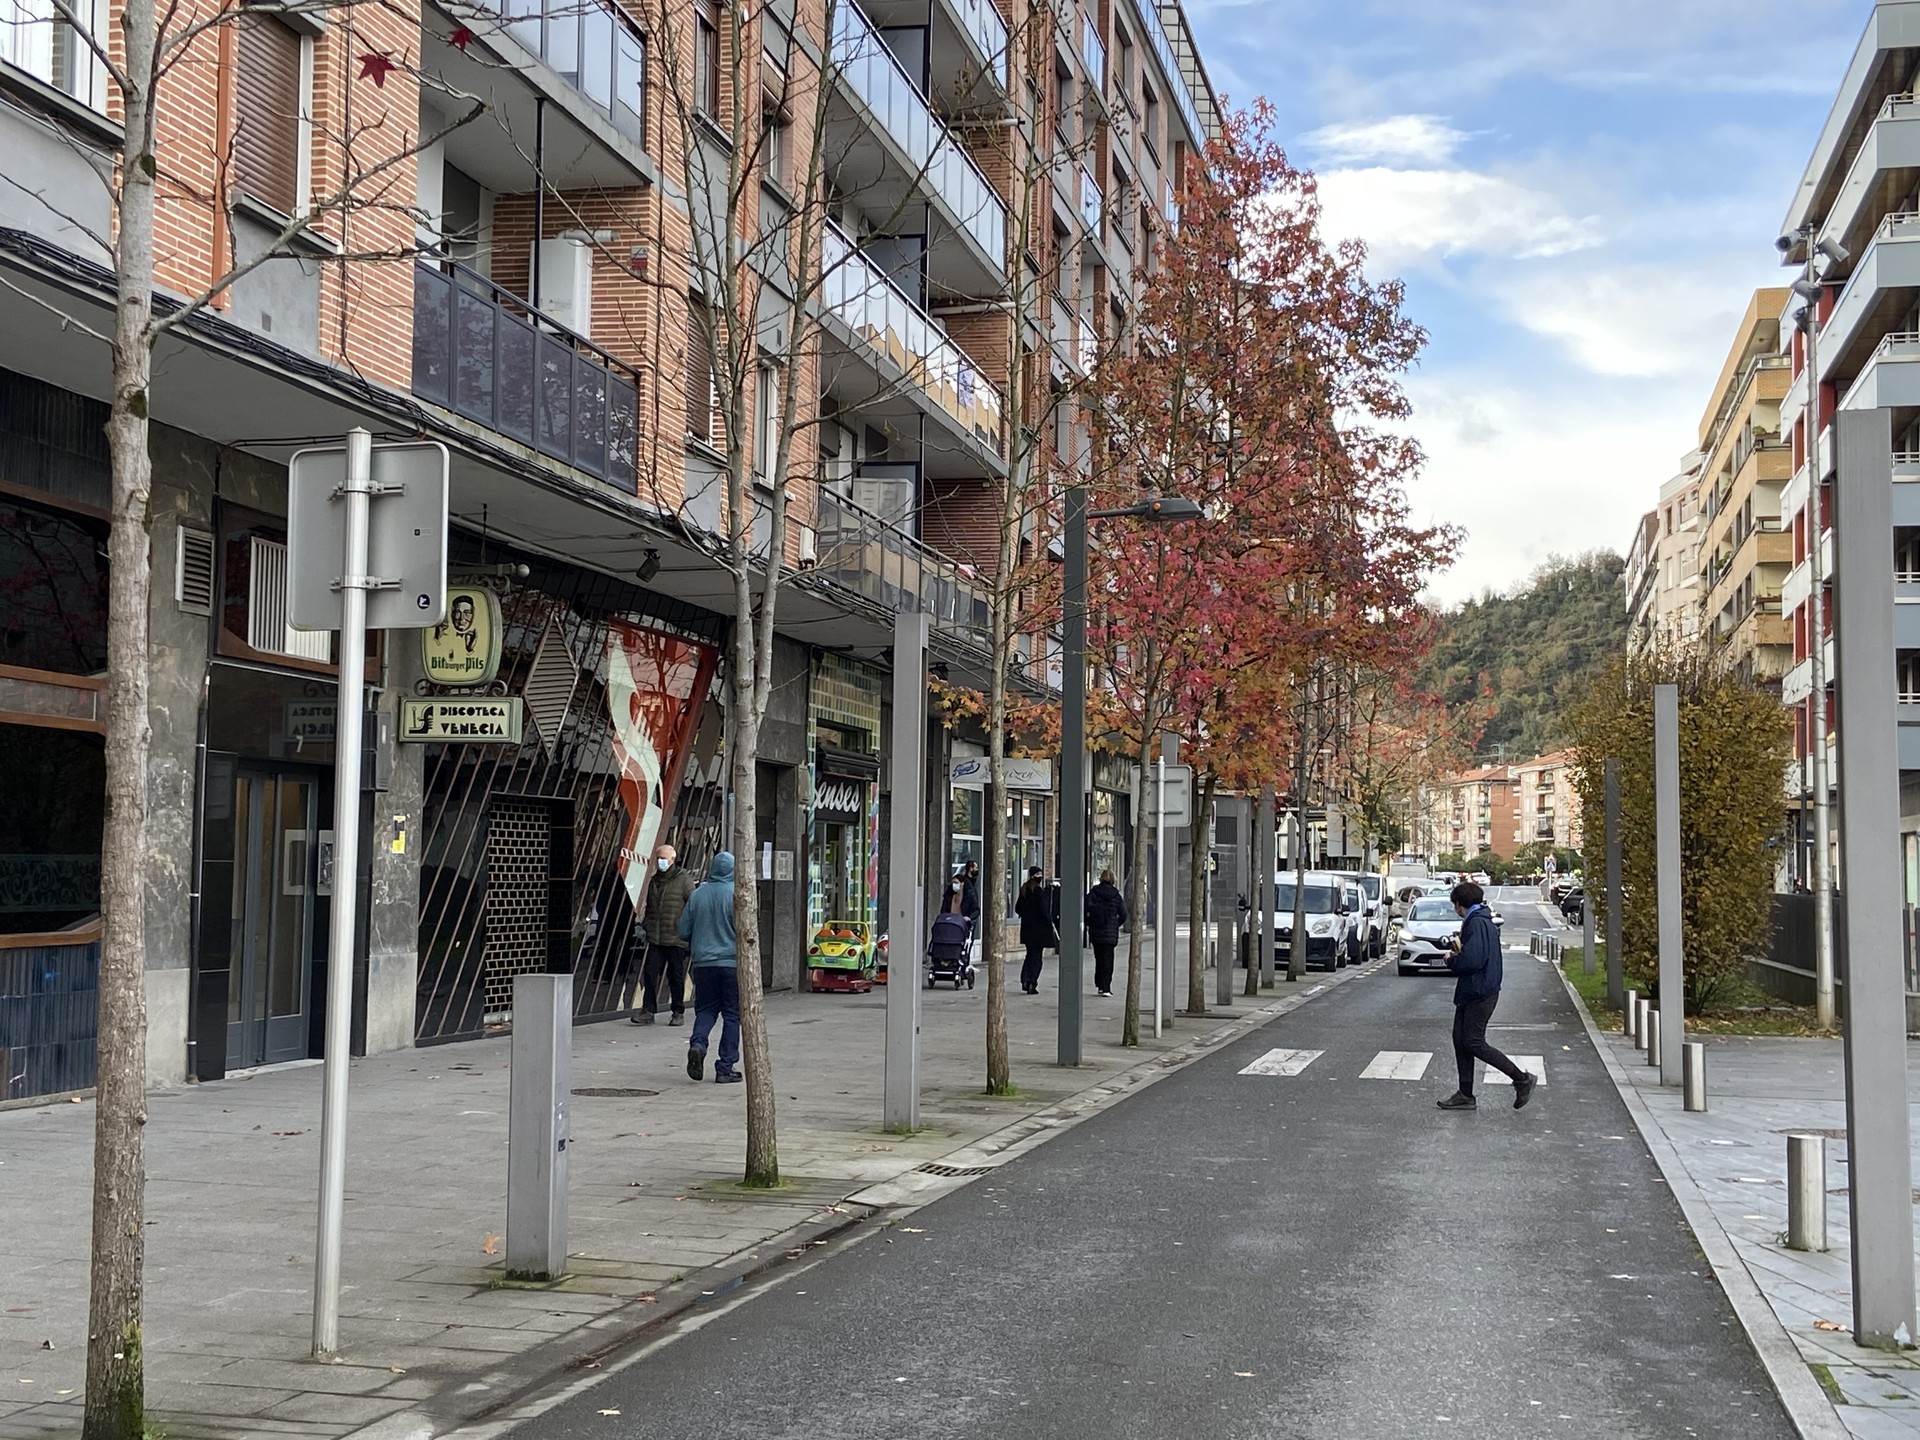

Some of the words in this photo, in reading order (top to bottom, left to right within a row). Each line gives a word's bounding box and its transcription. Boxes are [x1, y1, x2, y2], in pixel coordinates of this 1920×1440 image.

[465, 657, 484, 673] Pils
[440, 706, 505, 717] DISCOTECA
[440, 722, 504, 735] VENECIA
